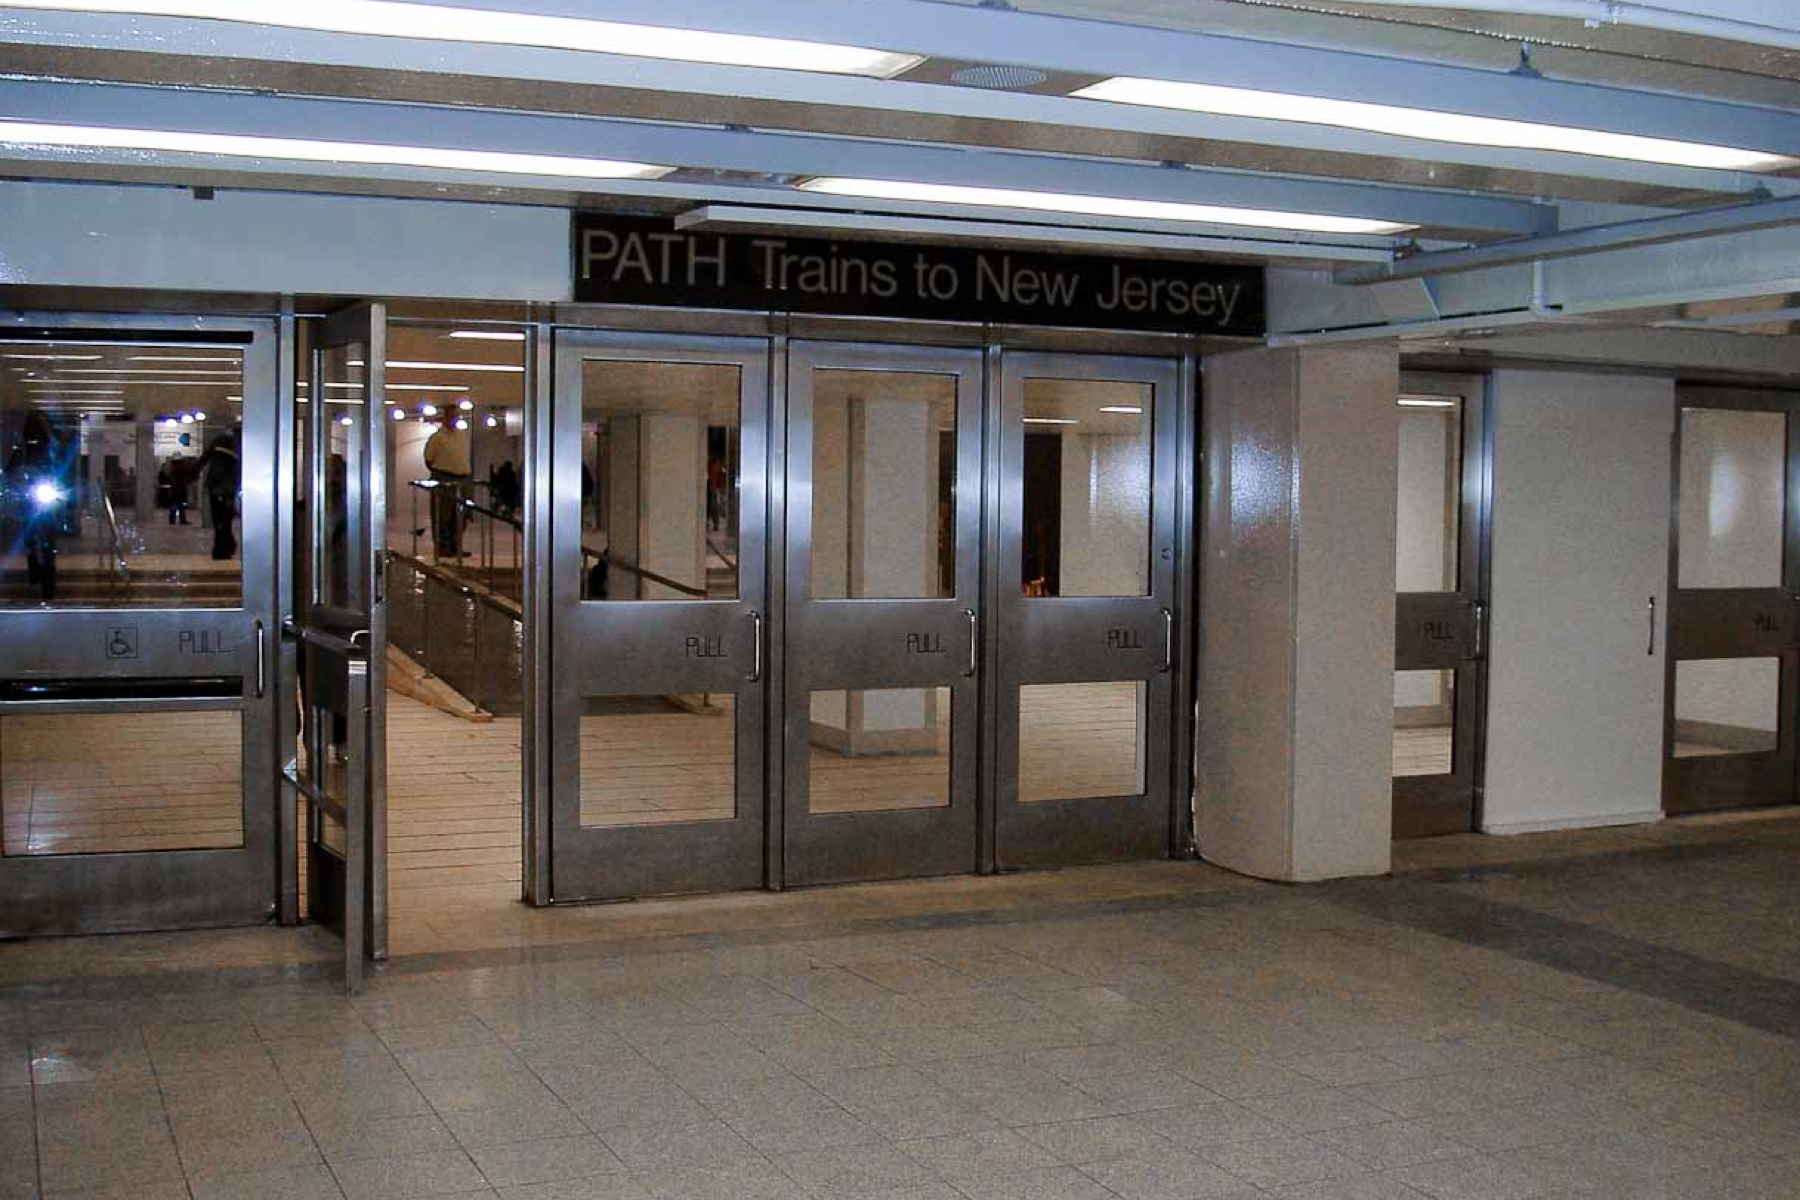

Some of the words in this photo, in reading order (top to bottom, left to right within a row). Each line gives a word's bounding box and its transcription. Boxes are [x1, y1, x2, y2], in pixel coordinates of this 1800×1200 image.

[582, 229, 726, 287] PATH
[751, 240, 897, 297] Trains
[915, 254, 959, 300] to
[975, 254, 1080, 307] New
[1096, 265, 1241, 326] Jersey
[178, 630, 233, 653] PULL
[686, 635, 728, 657] PULL
[907, 631, 946, 653] PULL
[1107, 628, 1144, 648] PULL
